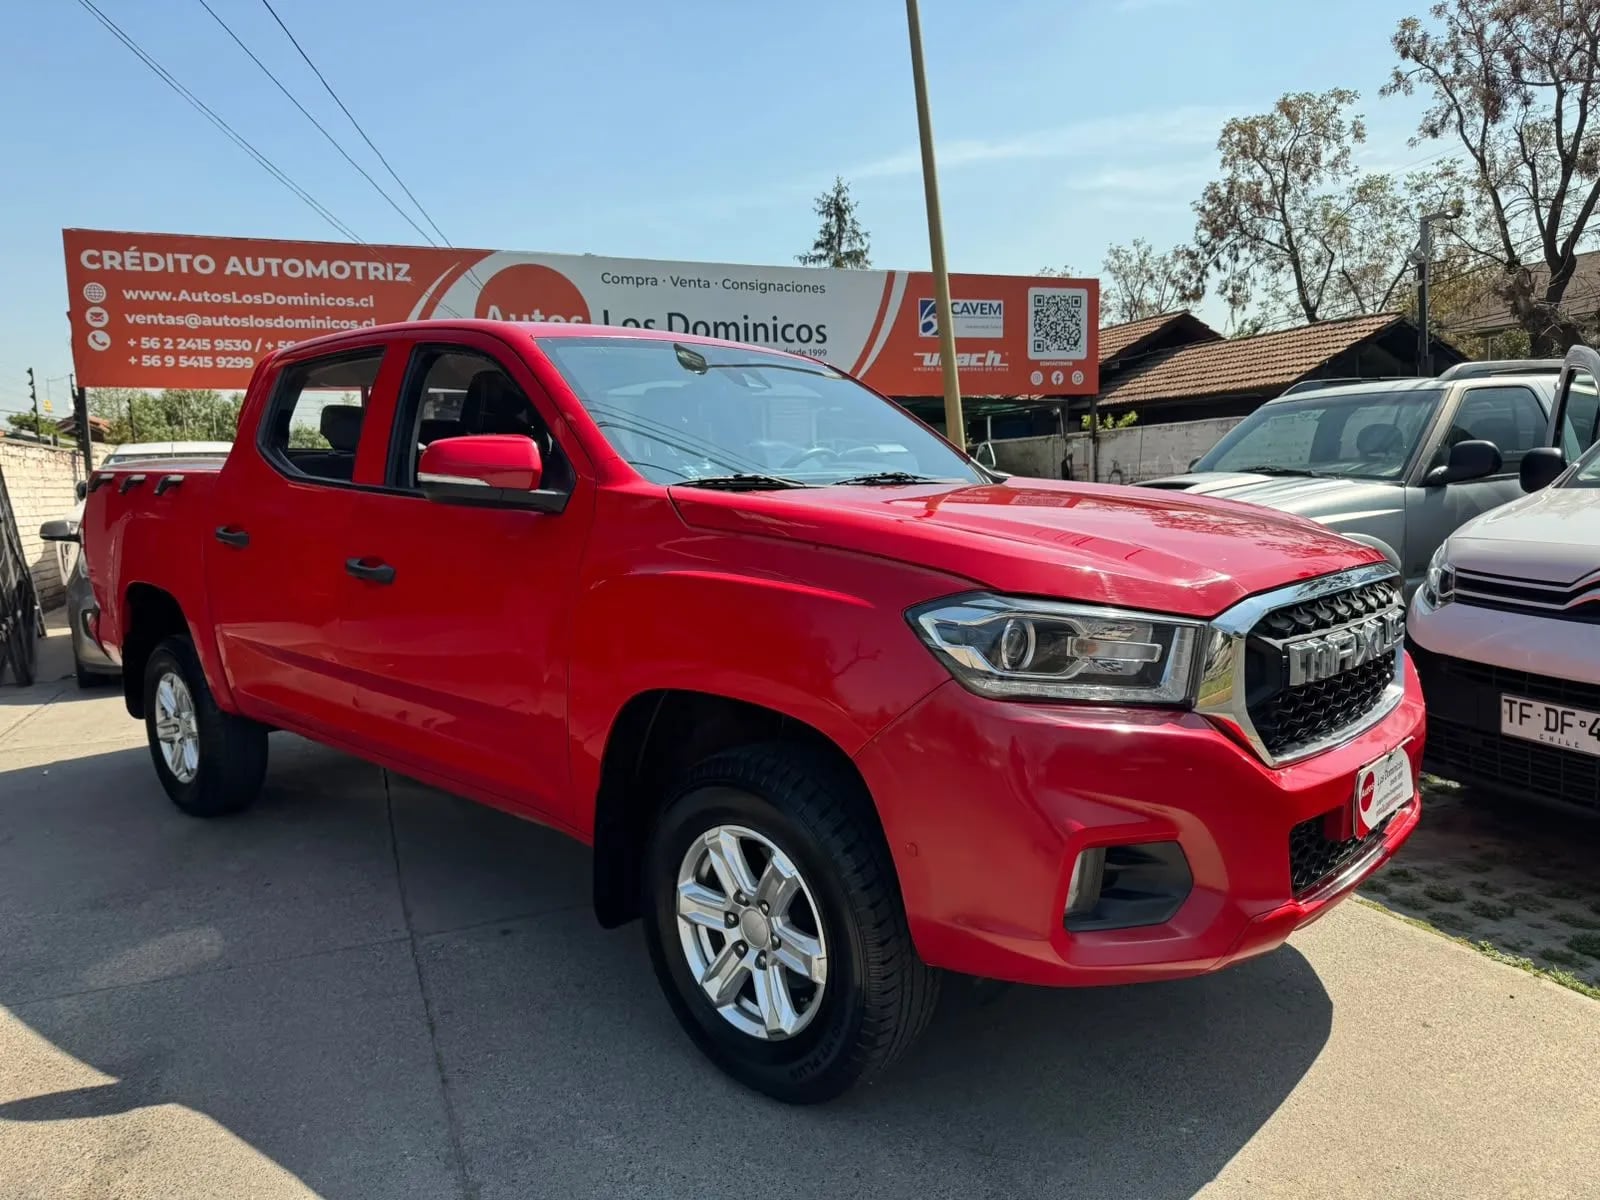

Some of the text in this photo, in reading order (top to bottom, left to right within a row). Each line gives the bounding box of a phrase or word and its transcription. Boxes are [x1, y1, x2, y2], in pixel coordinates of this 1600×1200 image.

[80, 246, 412, 282] CRÉDITO AUTOMOTRIZ
[601, 272, 826, 294] Compra Venta Consignaciones
[122, 289, 374, 307] www.AutosLosDominicos.cl
[950, 302, 1001, 315] CAVEM
[125, 313, 375, 330] ventas@autoslosdominicos.cl
[667, 312, 827, 344] Dominicos
[140, 336, 161, 350] 56
[163, 337, 174, 350] 2
[176, 338, 211, 351] 2415
[213, 339, 252, 352] 9530
[808, 348, 827, 357] 1999
[141, 355, 162, 367] 56
[164, 355, 175, 367] 9
[178, 355, 213, 369] 5415
[215, 356, 254, 369] 9299
[1289, 608, 1405, 686] MAXUS
[1539, 734, 1579, 749] CHILE
